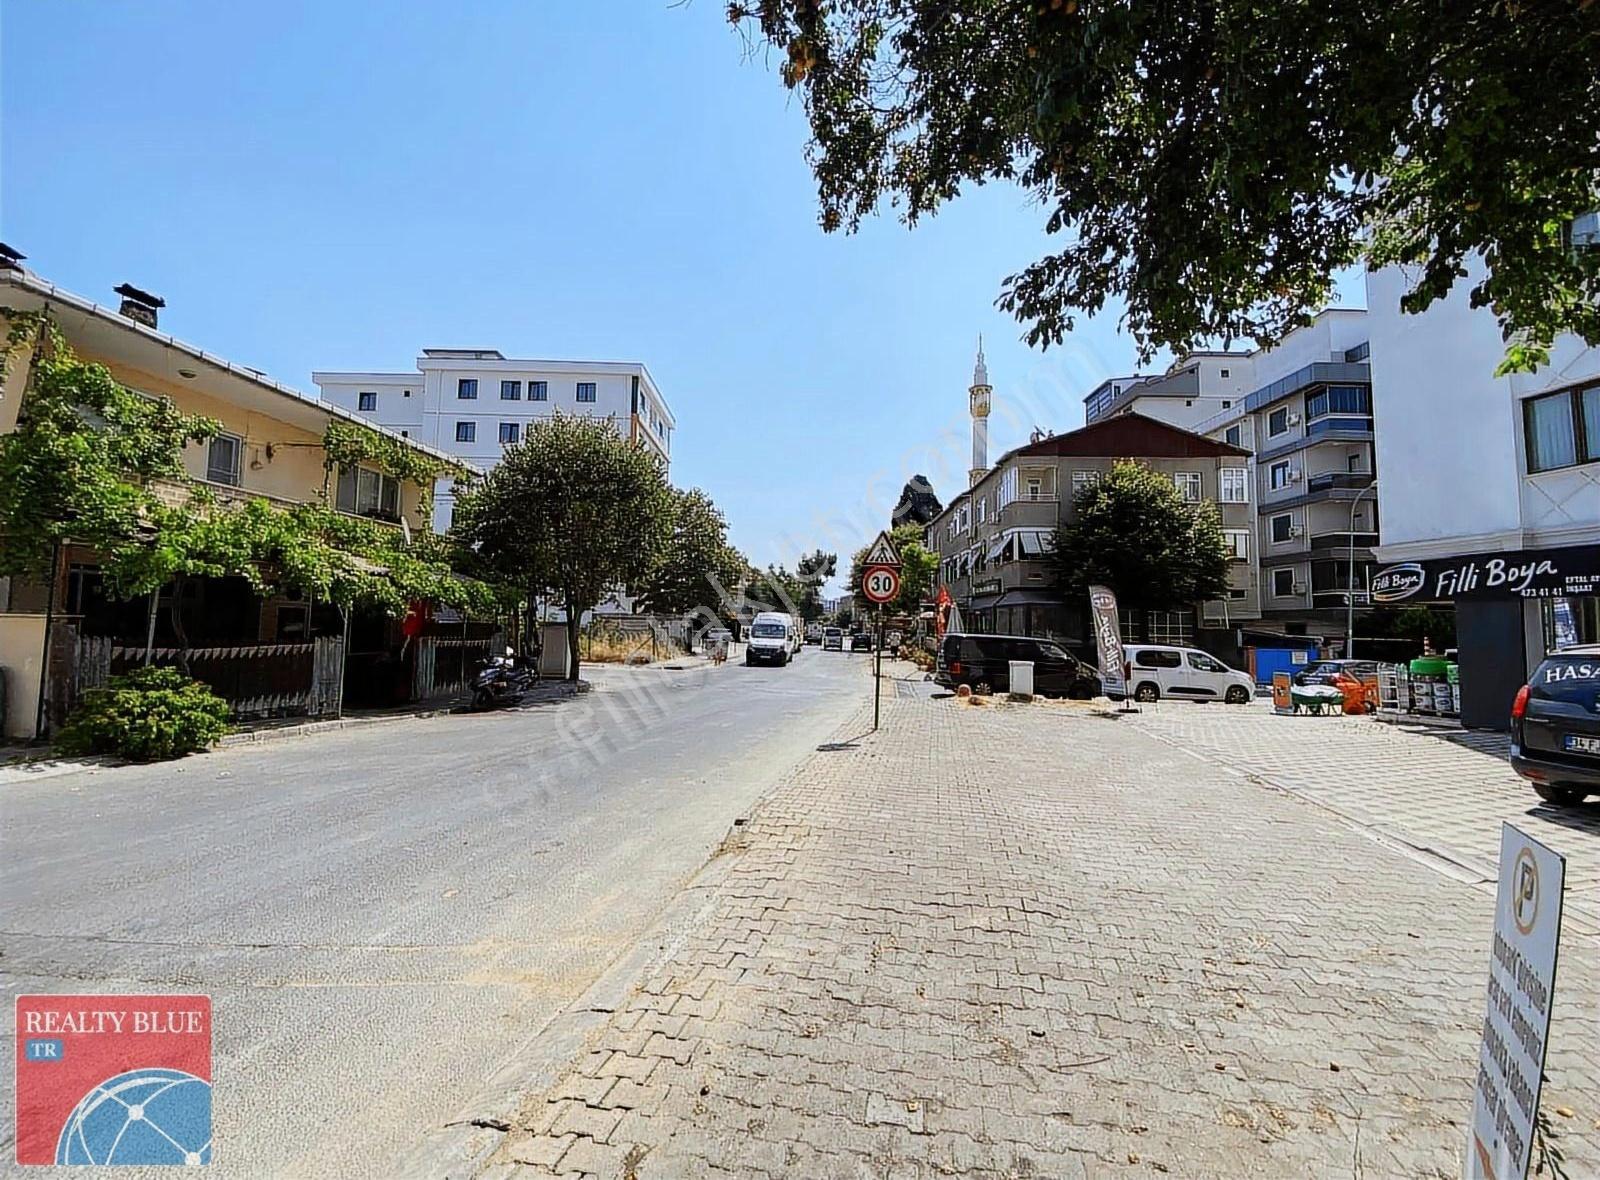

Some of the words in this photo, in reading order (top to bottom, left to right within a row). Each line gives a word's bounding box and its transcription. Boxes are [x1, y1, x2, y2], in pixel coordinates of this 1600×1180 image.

[871, 576, 891, 593] 30
[1371, 575, 1390, 592] Filli
[1392, 573, 1419, 590] Boya
[1435, 562, 1480, 598] Filli
[1485, 558, 1558, 592] Boya
[1539, 587, 1549, 597] 41
[1552, 587, 1562, 597] 41
